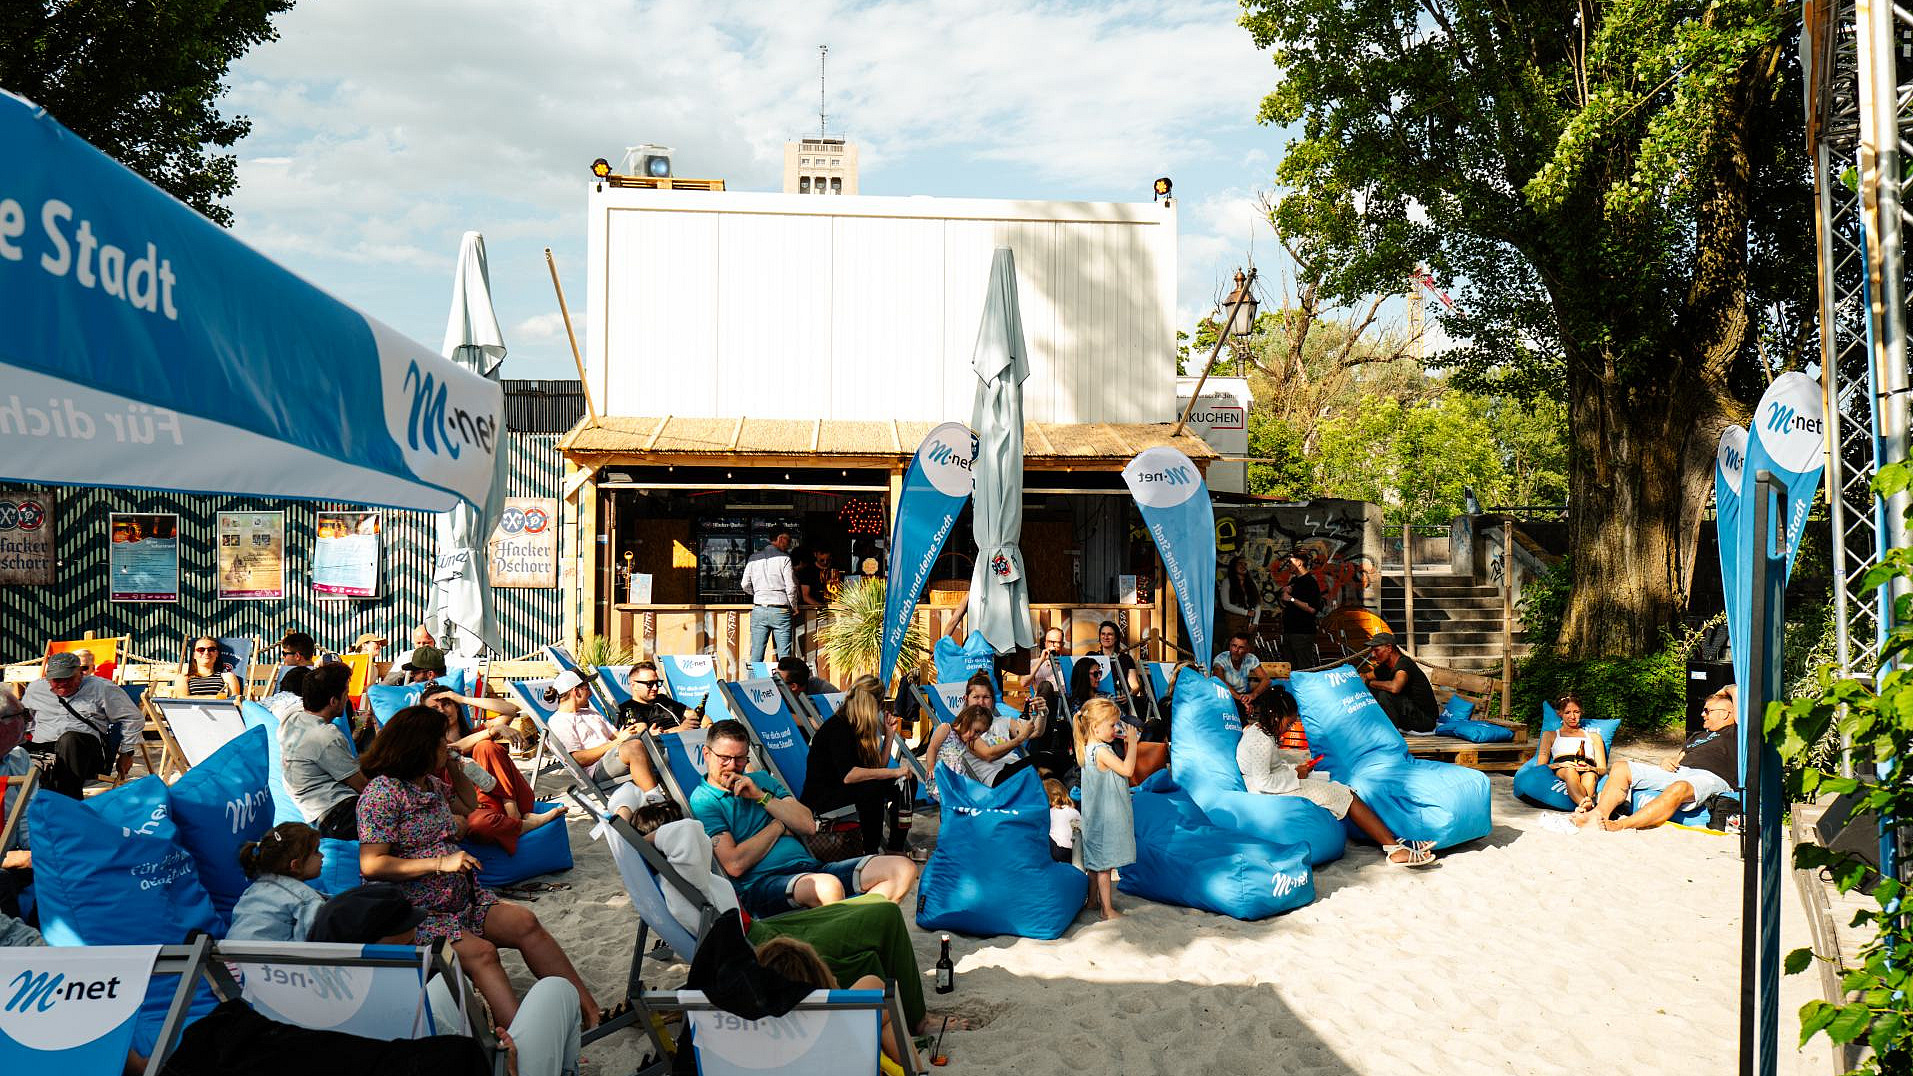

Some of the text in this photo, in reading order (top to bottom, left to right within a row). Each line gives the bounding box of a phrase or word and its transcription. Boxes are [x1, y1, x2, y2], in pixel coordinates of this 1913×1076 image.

[41, 198, 179, 321] Stadt
[1787, 498, 1806, 543] Stadt
[0, 553, 49, 570] schorr
[495, 541, 551, 558] Hacker
[492, 558, 551, 577] Pschorr
[890, 514, 954, 647] Für dich und deine Stadt
